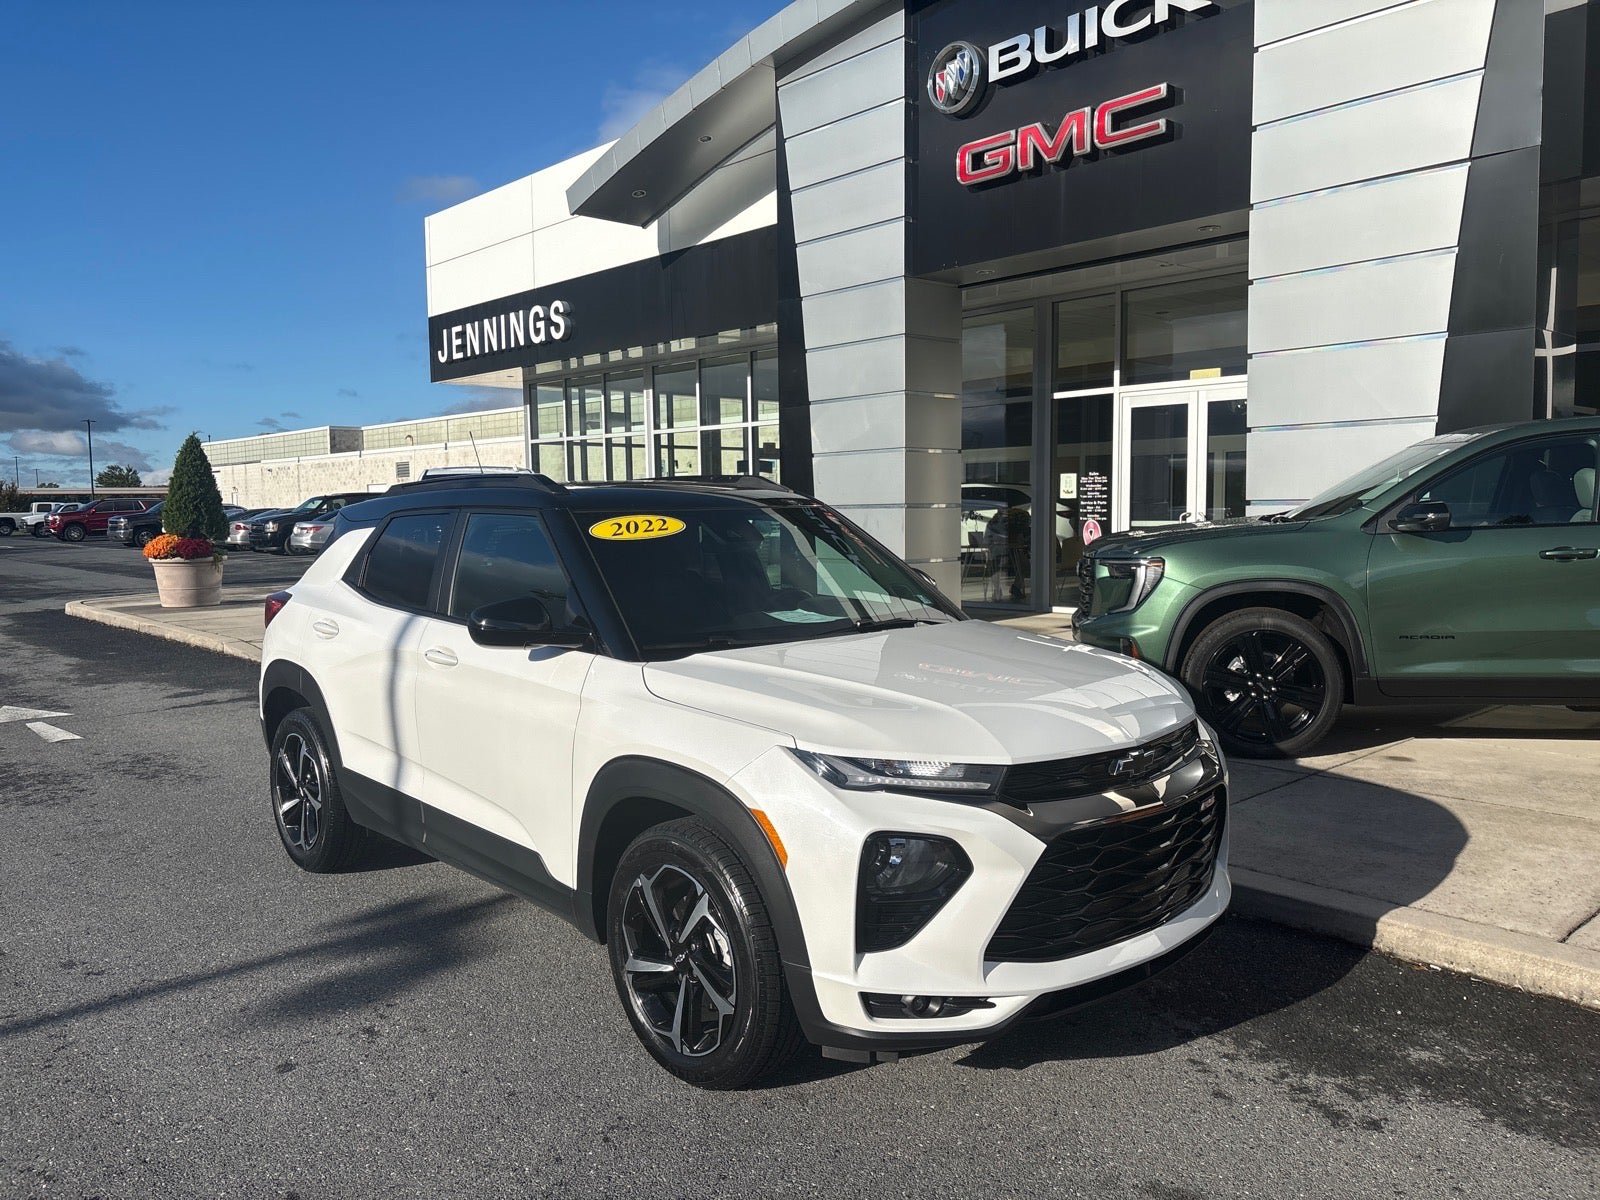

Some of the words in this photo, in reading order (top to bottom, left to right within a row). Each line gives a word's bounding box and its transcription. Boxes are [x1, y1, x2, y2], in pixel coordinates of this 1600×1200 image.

[956, 82, 1168, 186] GMC
[437, 300, 566, 363] JENNINGS
[609, 518, 669, 537] 2022
